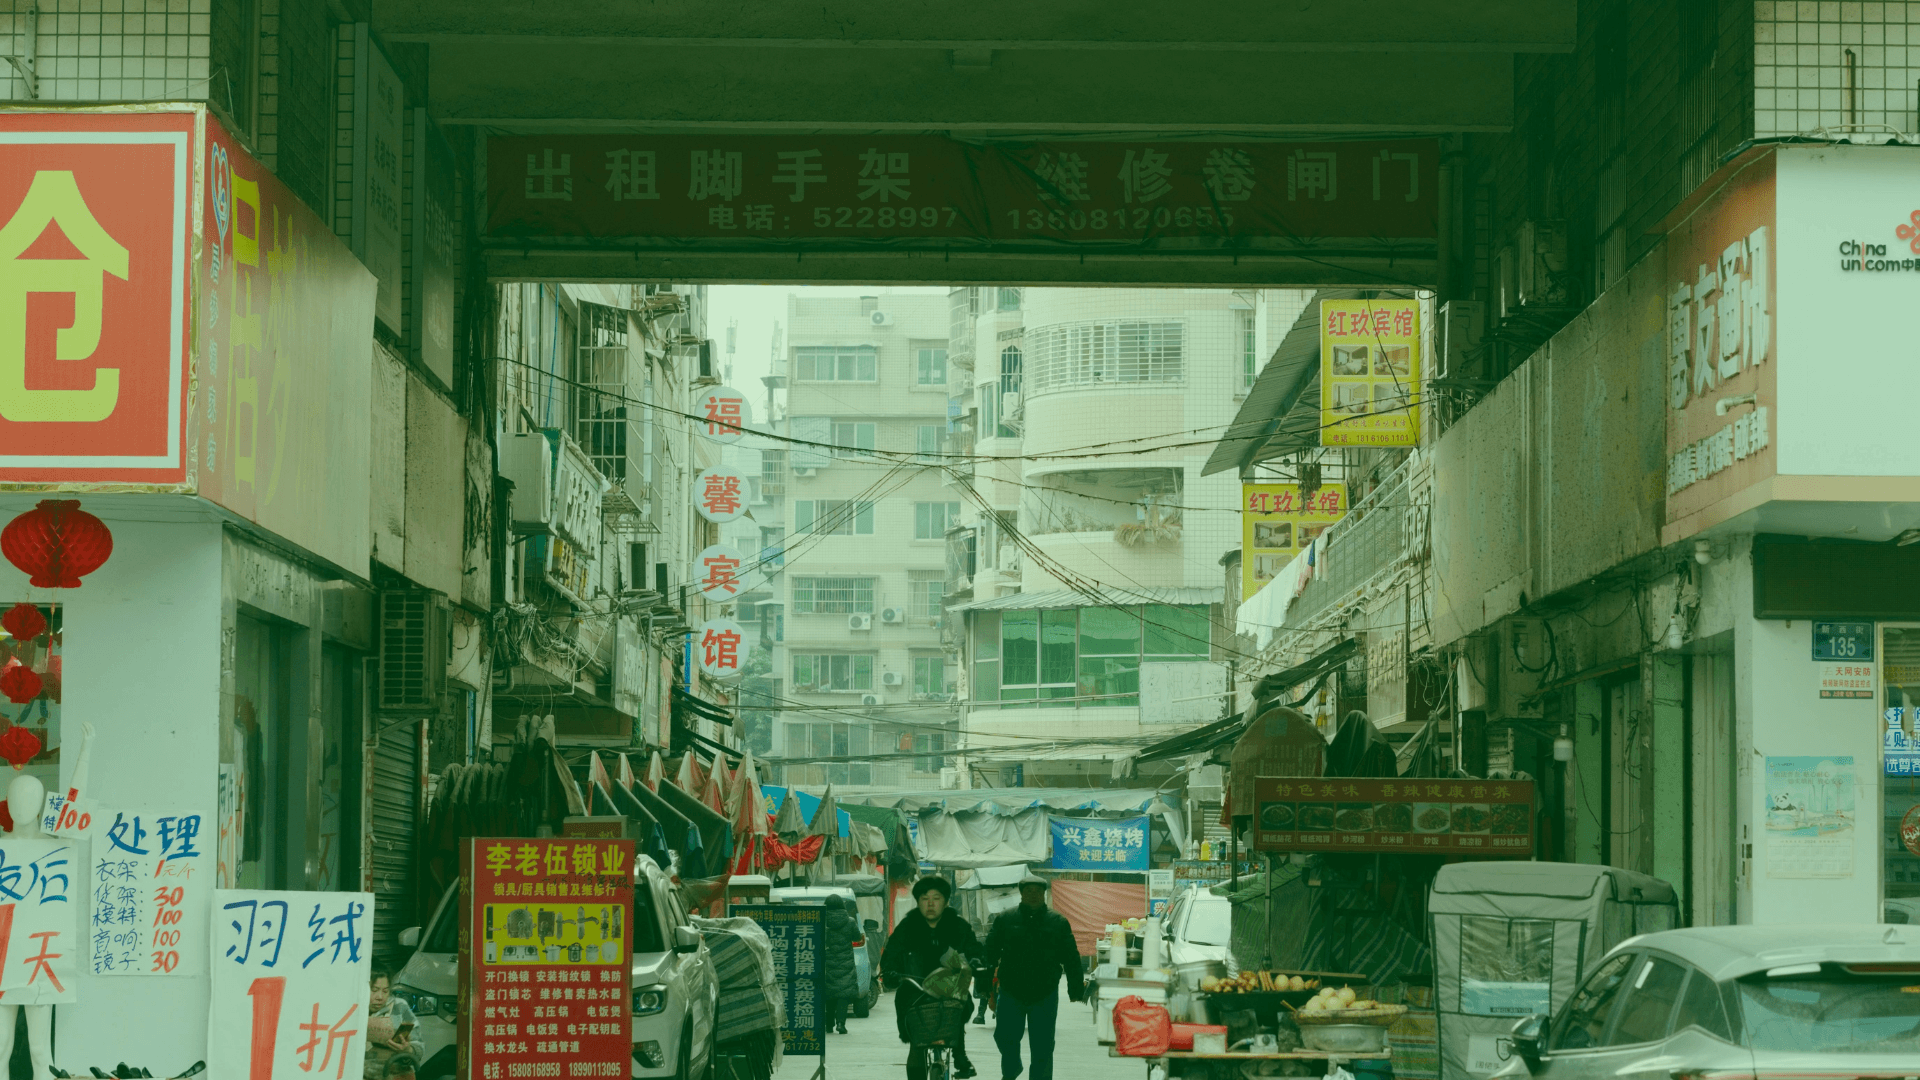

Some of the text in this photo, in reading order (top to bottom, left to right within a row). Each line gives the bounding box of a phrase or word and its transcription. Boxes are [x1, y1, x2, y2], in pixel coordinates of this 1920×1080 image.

[525, 148, 1419, 204] 出租脚手架 维修卷闸门
[813, 205, 958, 230] 5228997
[1008, 206, 1235, 230] 13608120655
[1839, 239, 1886, 256] China
[1841, 259, 1900, 272] unicom
[0, 170, 130, 422] 仓
[1328, 308, 1414, 337] 红玖宾馆
[702, 396, 743, 670] 福馨宾馆
[1829, 637, 1856, 657] 135
[1835, 667, 1871, 676] 天网安防
[1276, 784, 1511, 799] 特色美味 香辣健康营养
[54, 802, 92, 833] 100
[105, 811, 201, 862] 处理
[1062, 827, 1144, 848] 兴鑫烧烤
[1342, 835, 1365, 844] 炒河粉
[1381, 835, 1404, 845] 炒米粉
[1423, 836, 1439, 846] 炒饭
[486, 843, 626, 876] 李老伍锁业
[1079, 849, 1128, 862] 欢迎光临
[153, 885, 184, 907] 30
[493, 882, 617, 896] 锁具/厨具销售及维修行
[153, 907, 183, 928] 100
[153, 928, 181, 948] 100
[223, 900, 366, 969] 羽绒
[150, 949, 180, 974] 30
[485, 970, 621, 983] 开门换锁 安装指纹锁 换防
[794, 924, 816, 1028] 手机换屏 免费检测
[485, 988, 621, 1001] 盗门锁芯 维修售卖热水器
[485, 1006, 621, 1018] 燃气灶 高压锅 电饭煲
[247, 976, 360, 1080] 1折
[485, 1023, 621, 1036] 高压锅 电饭煲 电子配钥匙
[484, 1041, 581, 1054] 换水龙头 疏通管道
[508, 1062, 560, 1078] 15808168958
[568, 1062, 621, 1077] 18990113095
